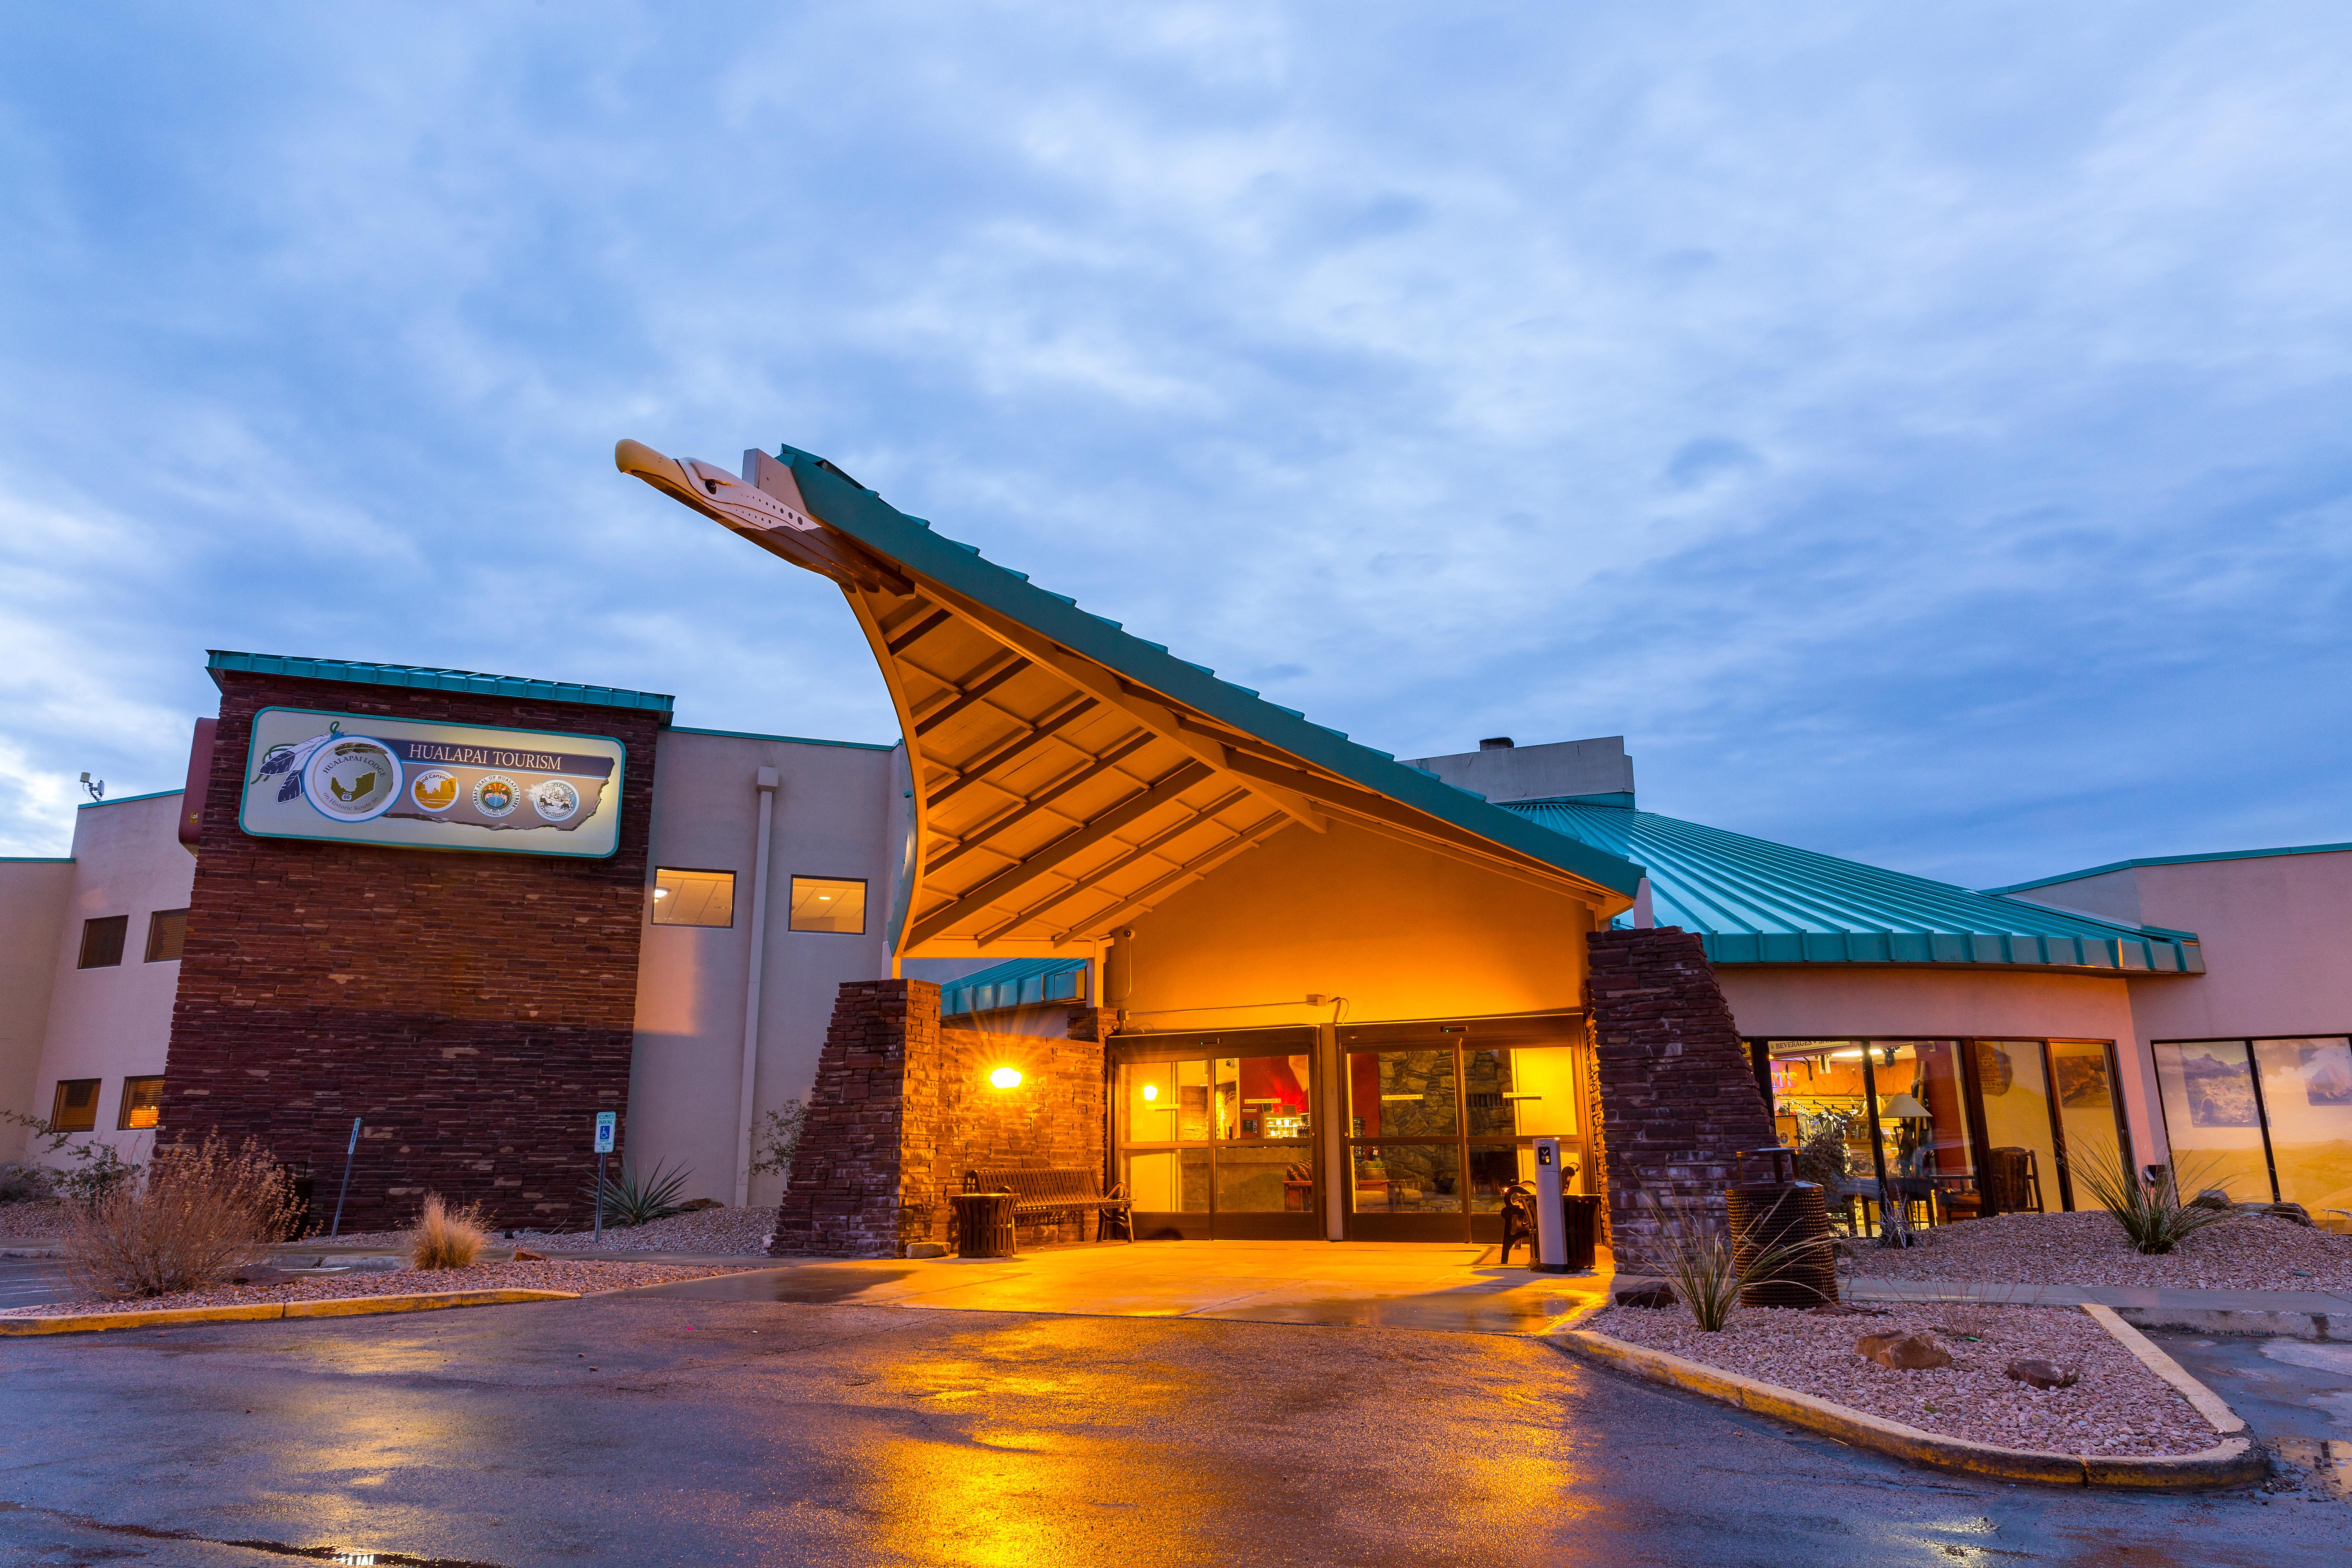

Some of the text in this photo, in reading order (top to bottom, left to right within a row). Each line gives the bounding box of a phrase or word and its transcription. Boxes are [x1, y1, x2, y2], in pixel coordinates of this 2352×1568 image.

[409, 744, 561, 770] HUALAPAI TOURISM
[323, 755, 387, 777] HUALAPAI LODGE
[416, 776, 429, 790] Grand
[477, 779, 488, 788] SEAL
[498, 775, 519, 793] HUALAPAI
[329, 798, 353, 811] Historic
[354, 802, 372, 811] Route
[477, 805, 486, 813] PEACH
[539, 802, 574, 817] River Runners
[1776, 1041, 1812, 1049] BEVERAGES
